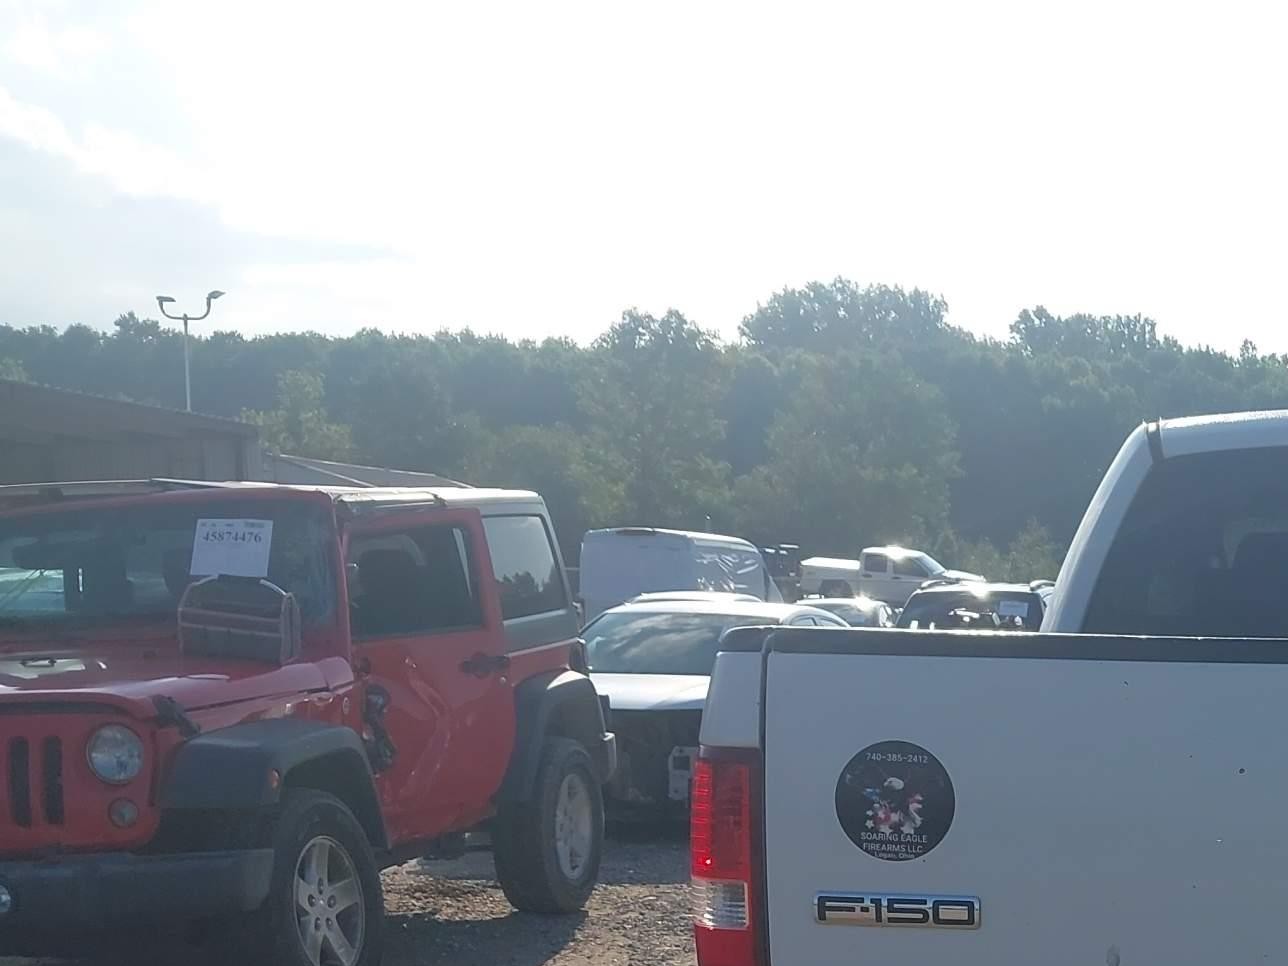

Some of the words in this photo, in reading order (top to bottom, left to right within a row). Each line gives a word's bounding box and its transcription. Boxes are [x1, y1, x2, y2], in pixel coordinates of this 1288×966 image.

[202, 531, 262, 543] 45874476
[865, 752, 929, 763] 740-385-2412
[860, 832, 899, 842] SOARING
[900, 834, 928, 843] EAGLE
[863, 842, 906, 852] FIREARMS
[907, 845, 923, 853] LLC
